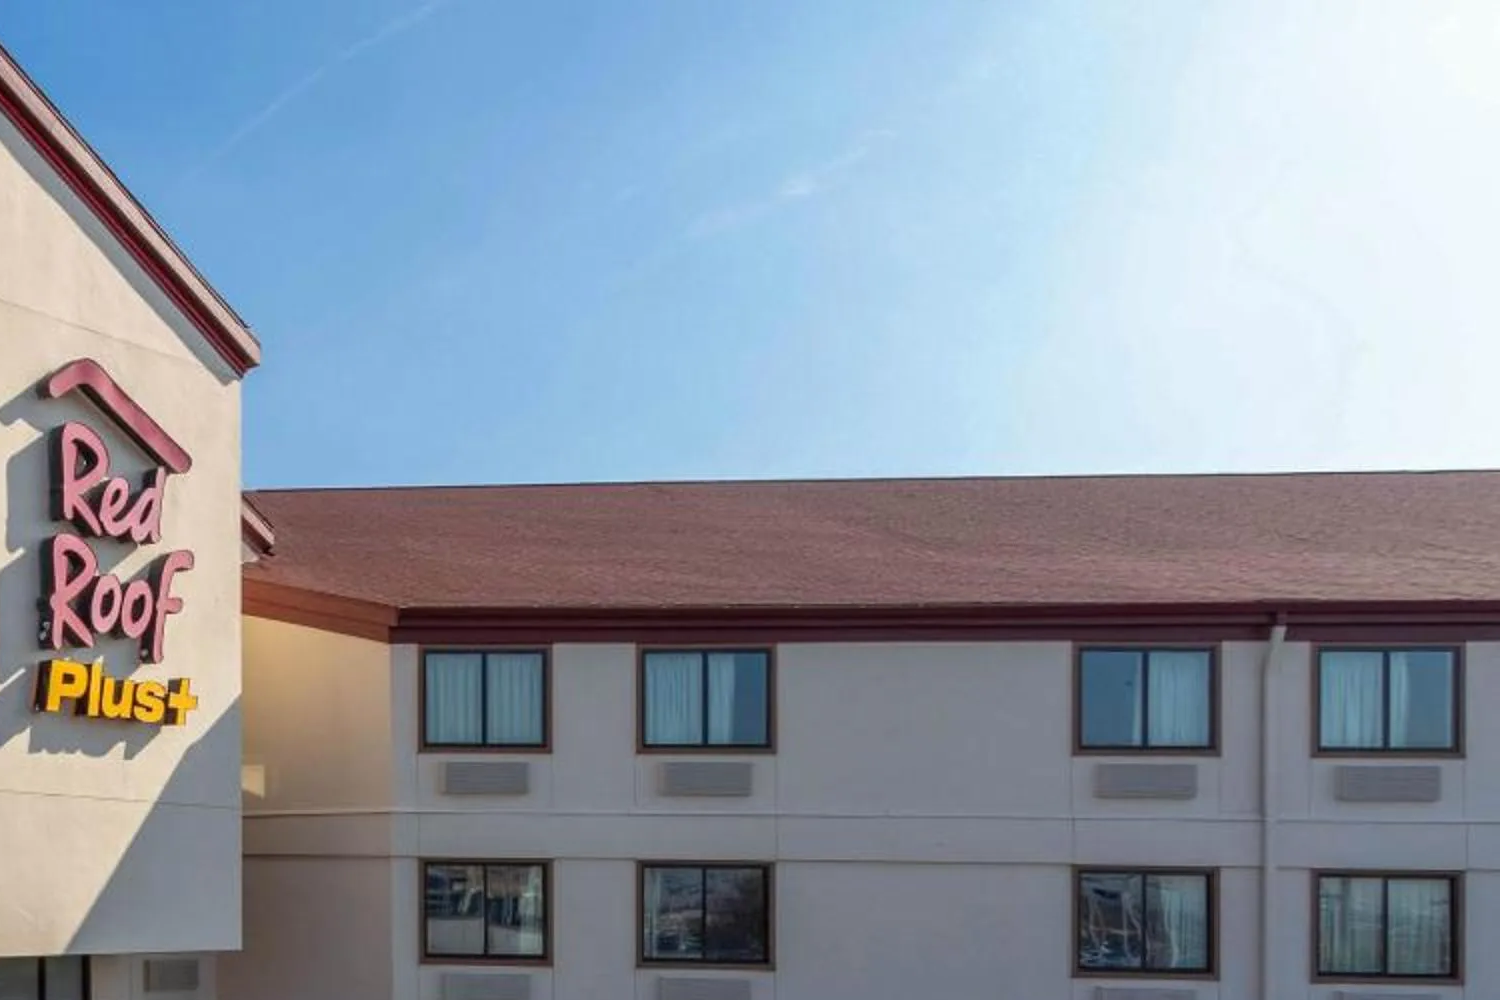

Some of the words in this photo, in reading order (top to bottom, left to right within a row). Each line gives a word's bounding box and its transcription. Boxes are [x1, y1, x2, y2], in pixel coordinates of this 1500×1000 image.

[61, 421, 167, 544] Red
[50, 533, 195, 664] Roof
[45, 658, 198, 726] Plus+
